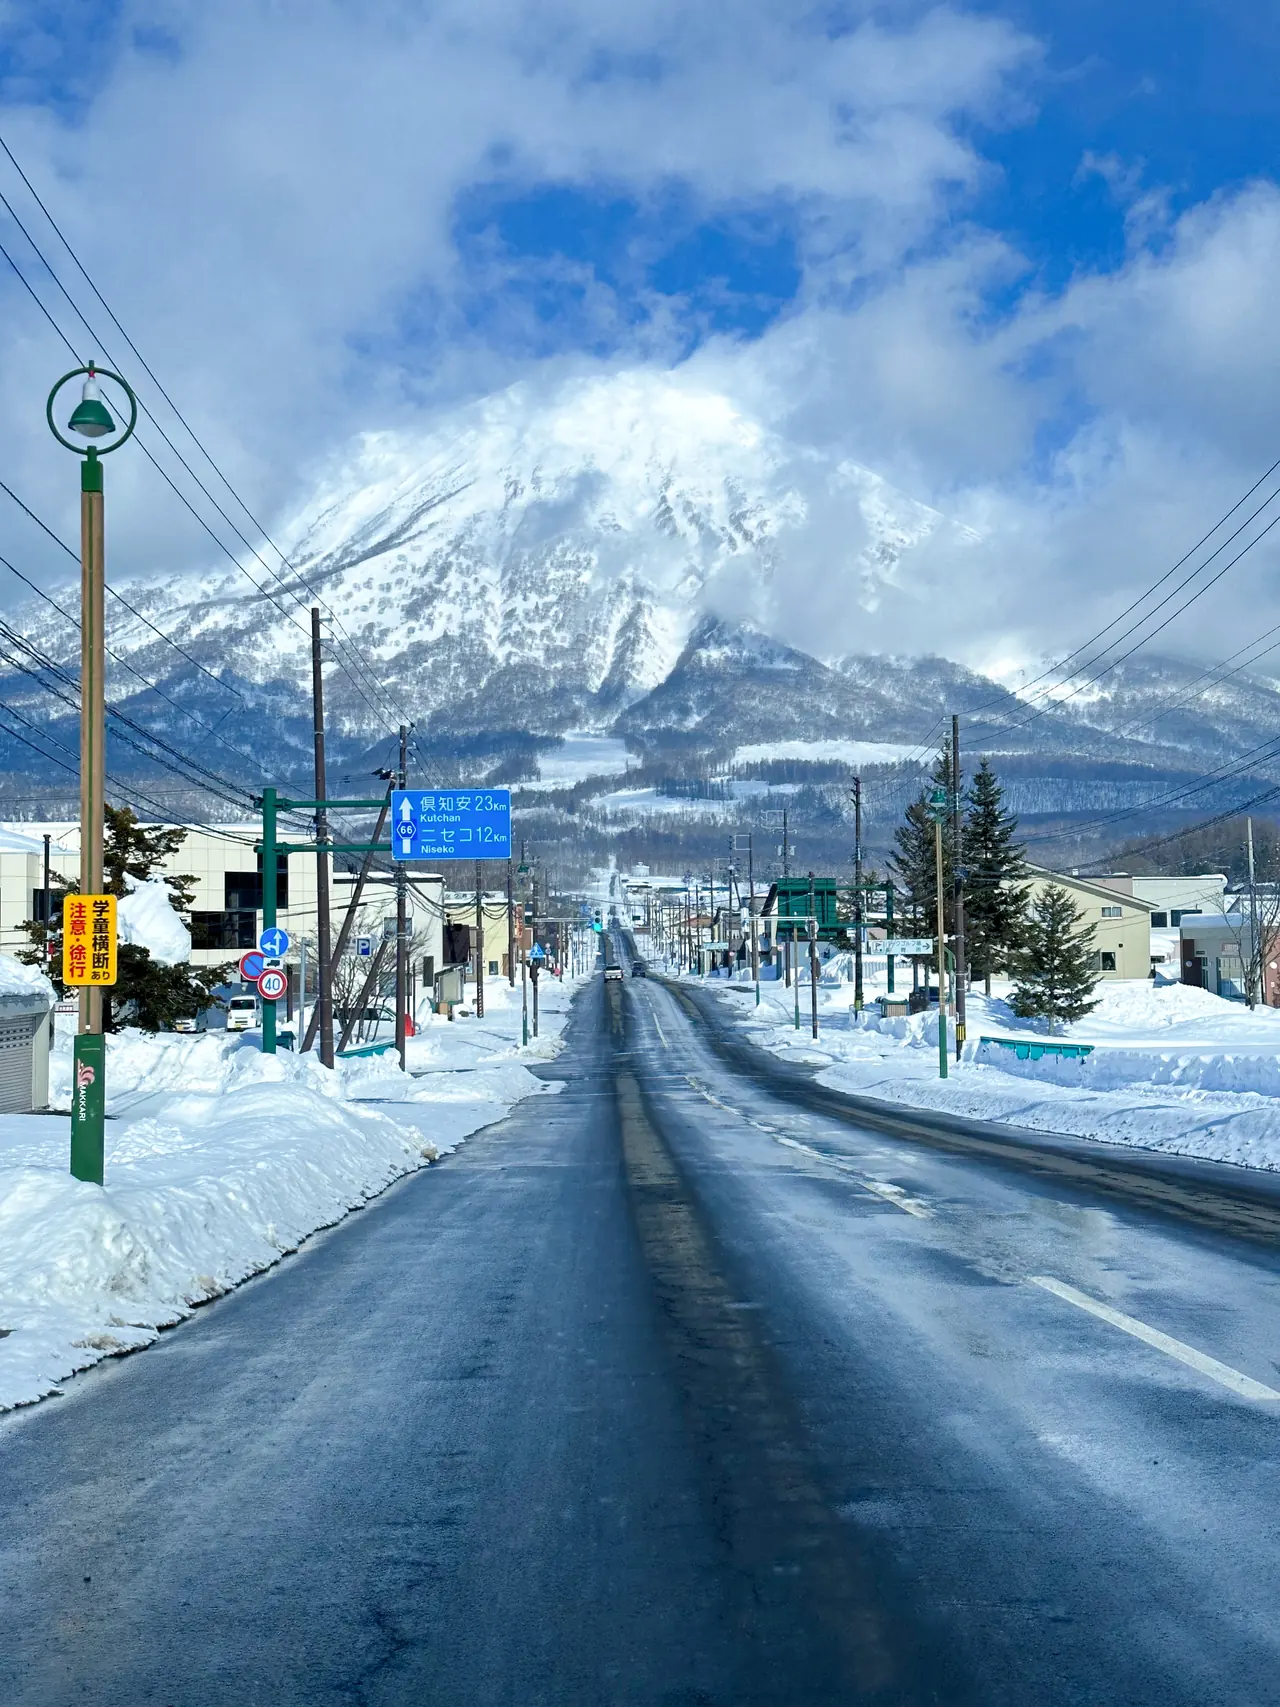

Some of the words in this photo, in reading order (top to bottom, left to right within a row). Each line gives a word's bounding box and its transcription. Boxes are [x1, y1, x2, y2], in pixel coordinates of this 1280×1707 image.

[420, 813, 461, 822] Kutchan
[400, 825, 413, 835] 66
[421, 828, 473, 842] ニセコ
[421, 845, 455, 853] Niseko
[359, 940, 370, 955] P
[264, 978, 280, 991] 40
[79, 1084, 87, 1121] MAKKARI
